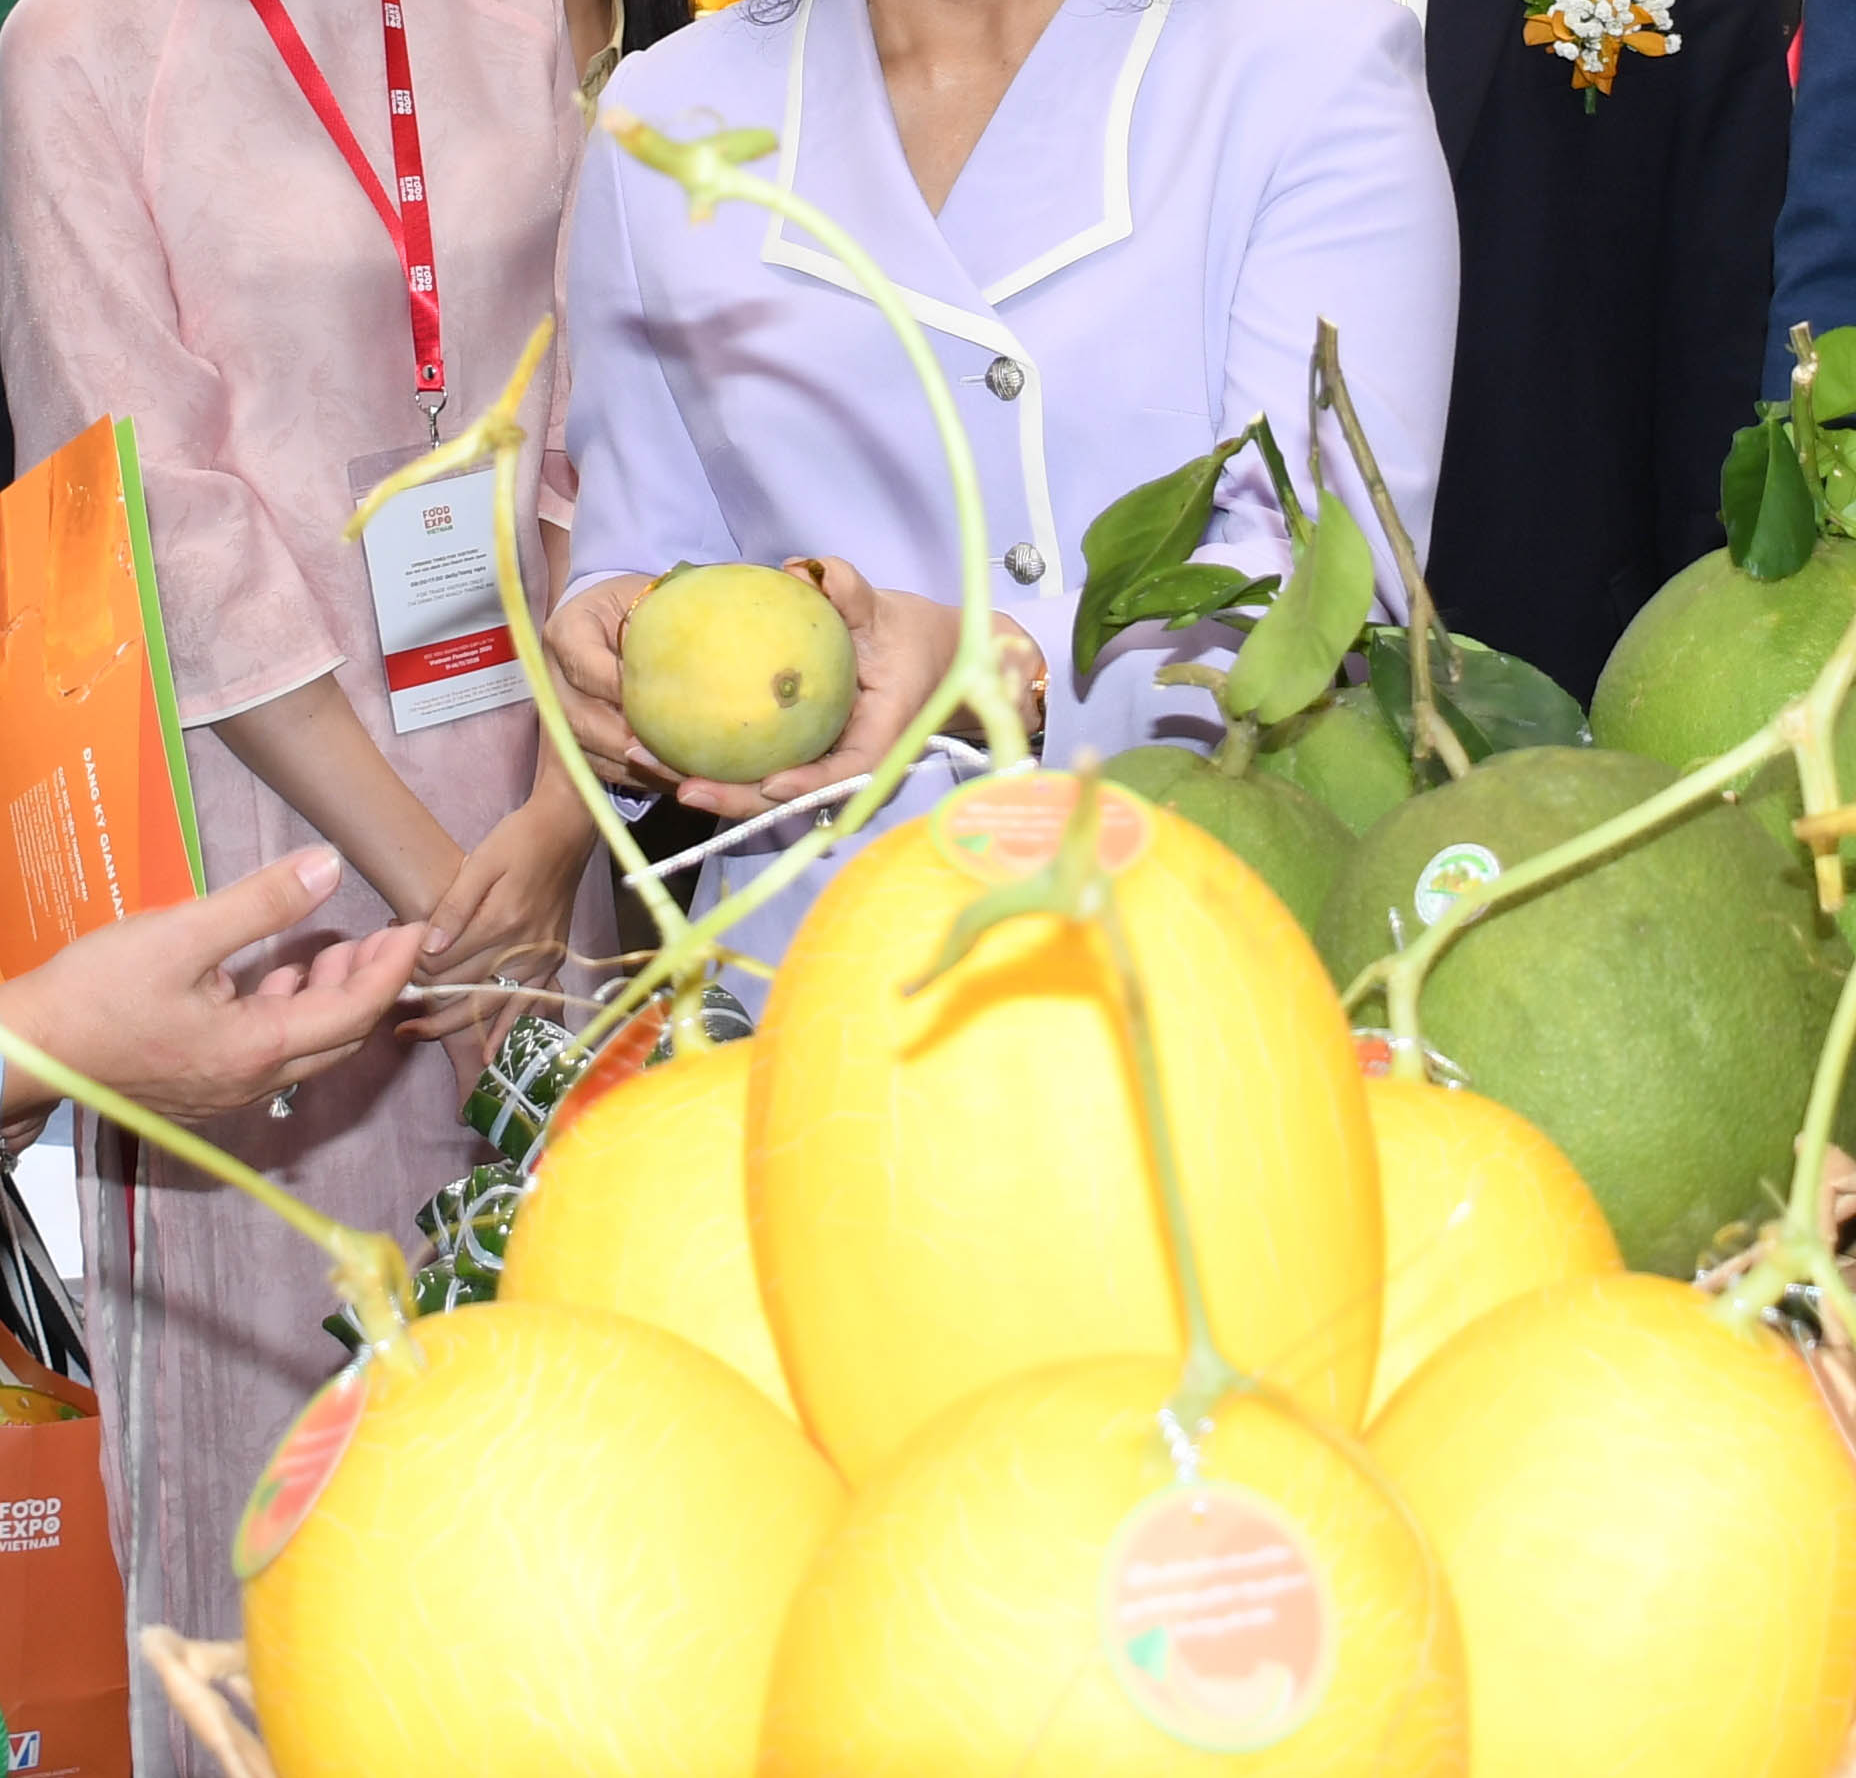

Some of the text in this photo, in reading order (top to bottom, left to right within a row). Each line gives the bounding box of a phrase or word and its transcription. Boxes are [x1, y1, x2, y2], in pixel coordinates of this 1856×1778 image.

[422, 505, 451, 519] FOOD
[424, 515, 452, 529] EXPO
[109, 882, 125, 921] HÀN
